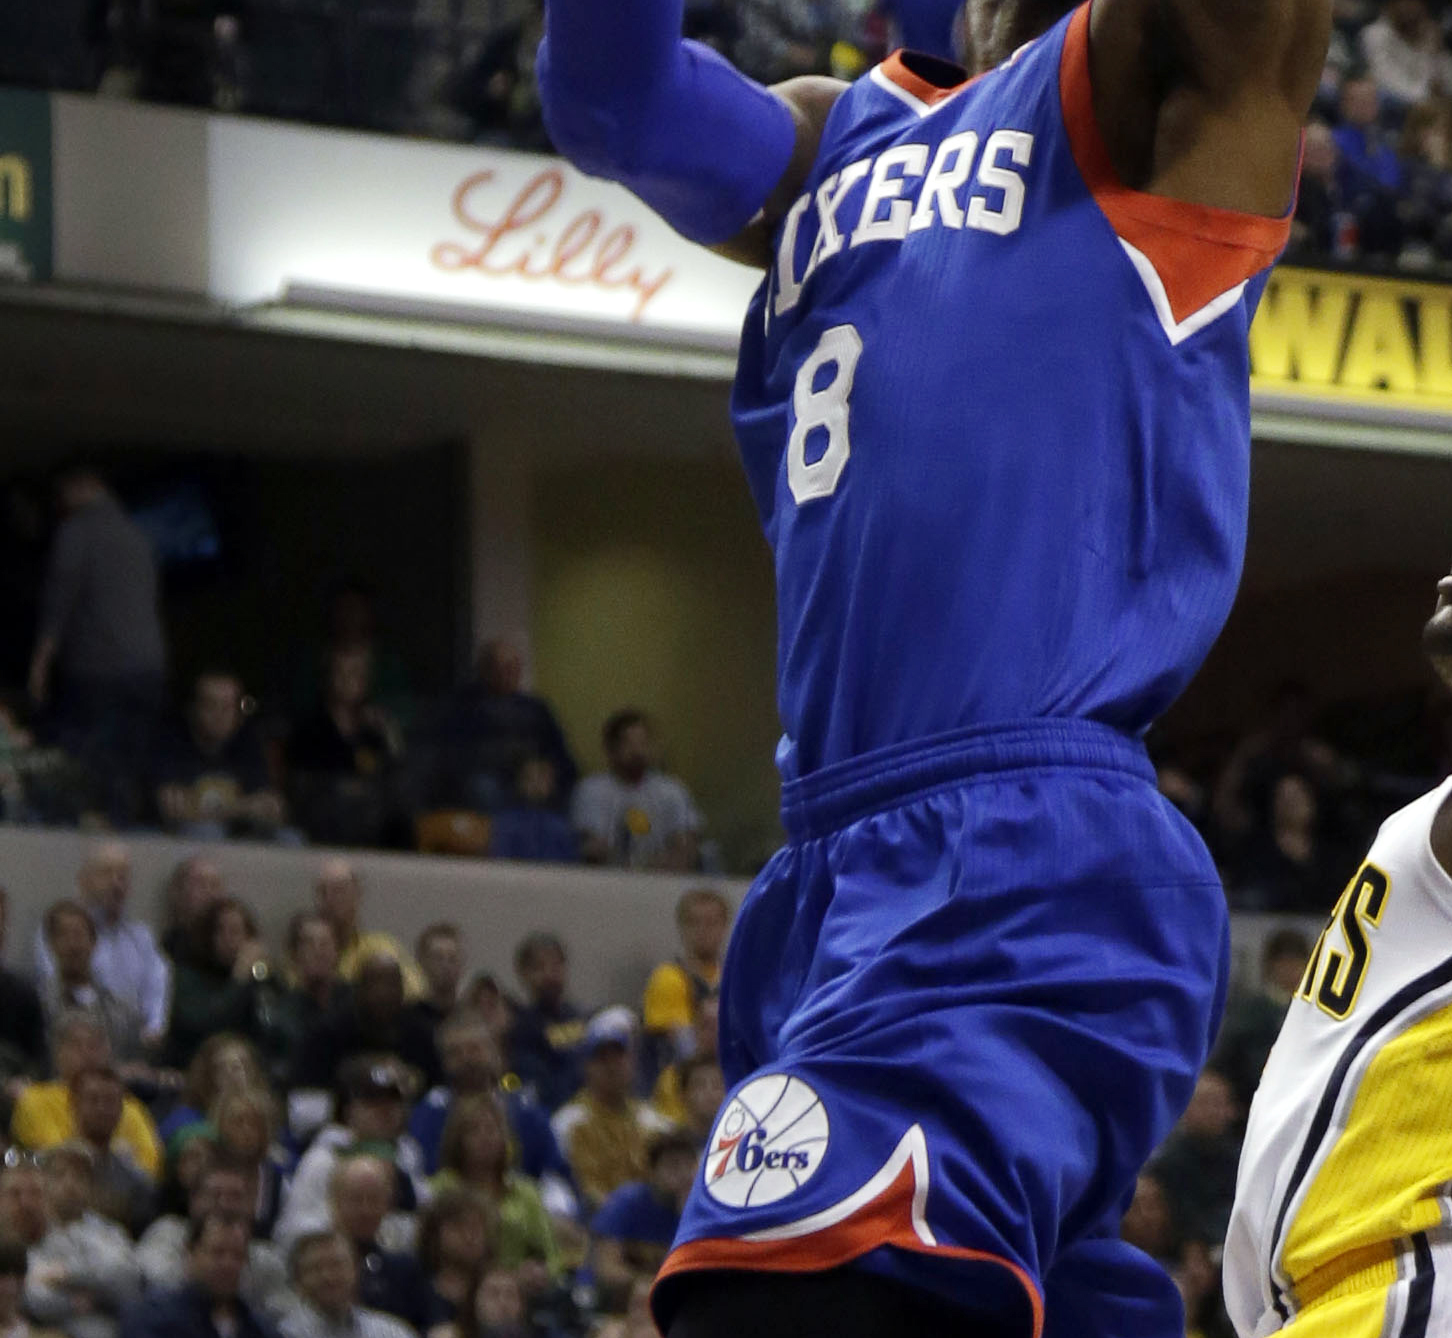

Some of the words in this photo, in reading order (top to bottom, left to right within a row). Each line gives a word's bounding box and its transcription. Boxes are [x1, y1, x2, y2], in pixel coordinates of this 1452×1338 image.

[430, 167, 674, 321] Lilly
[763, 128, 1035, 337] IXERS
[786, 322, 864, 505] 8
[711, 1126, 810, 1180] 76ers
